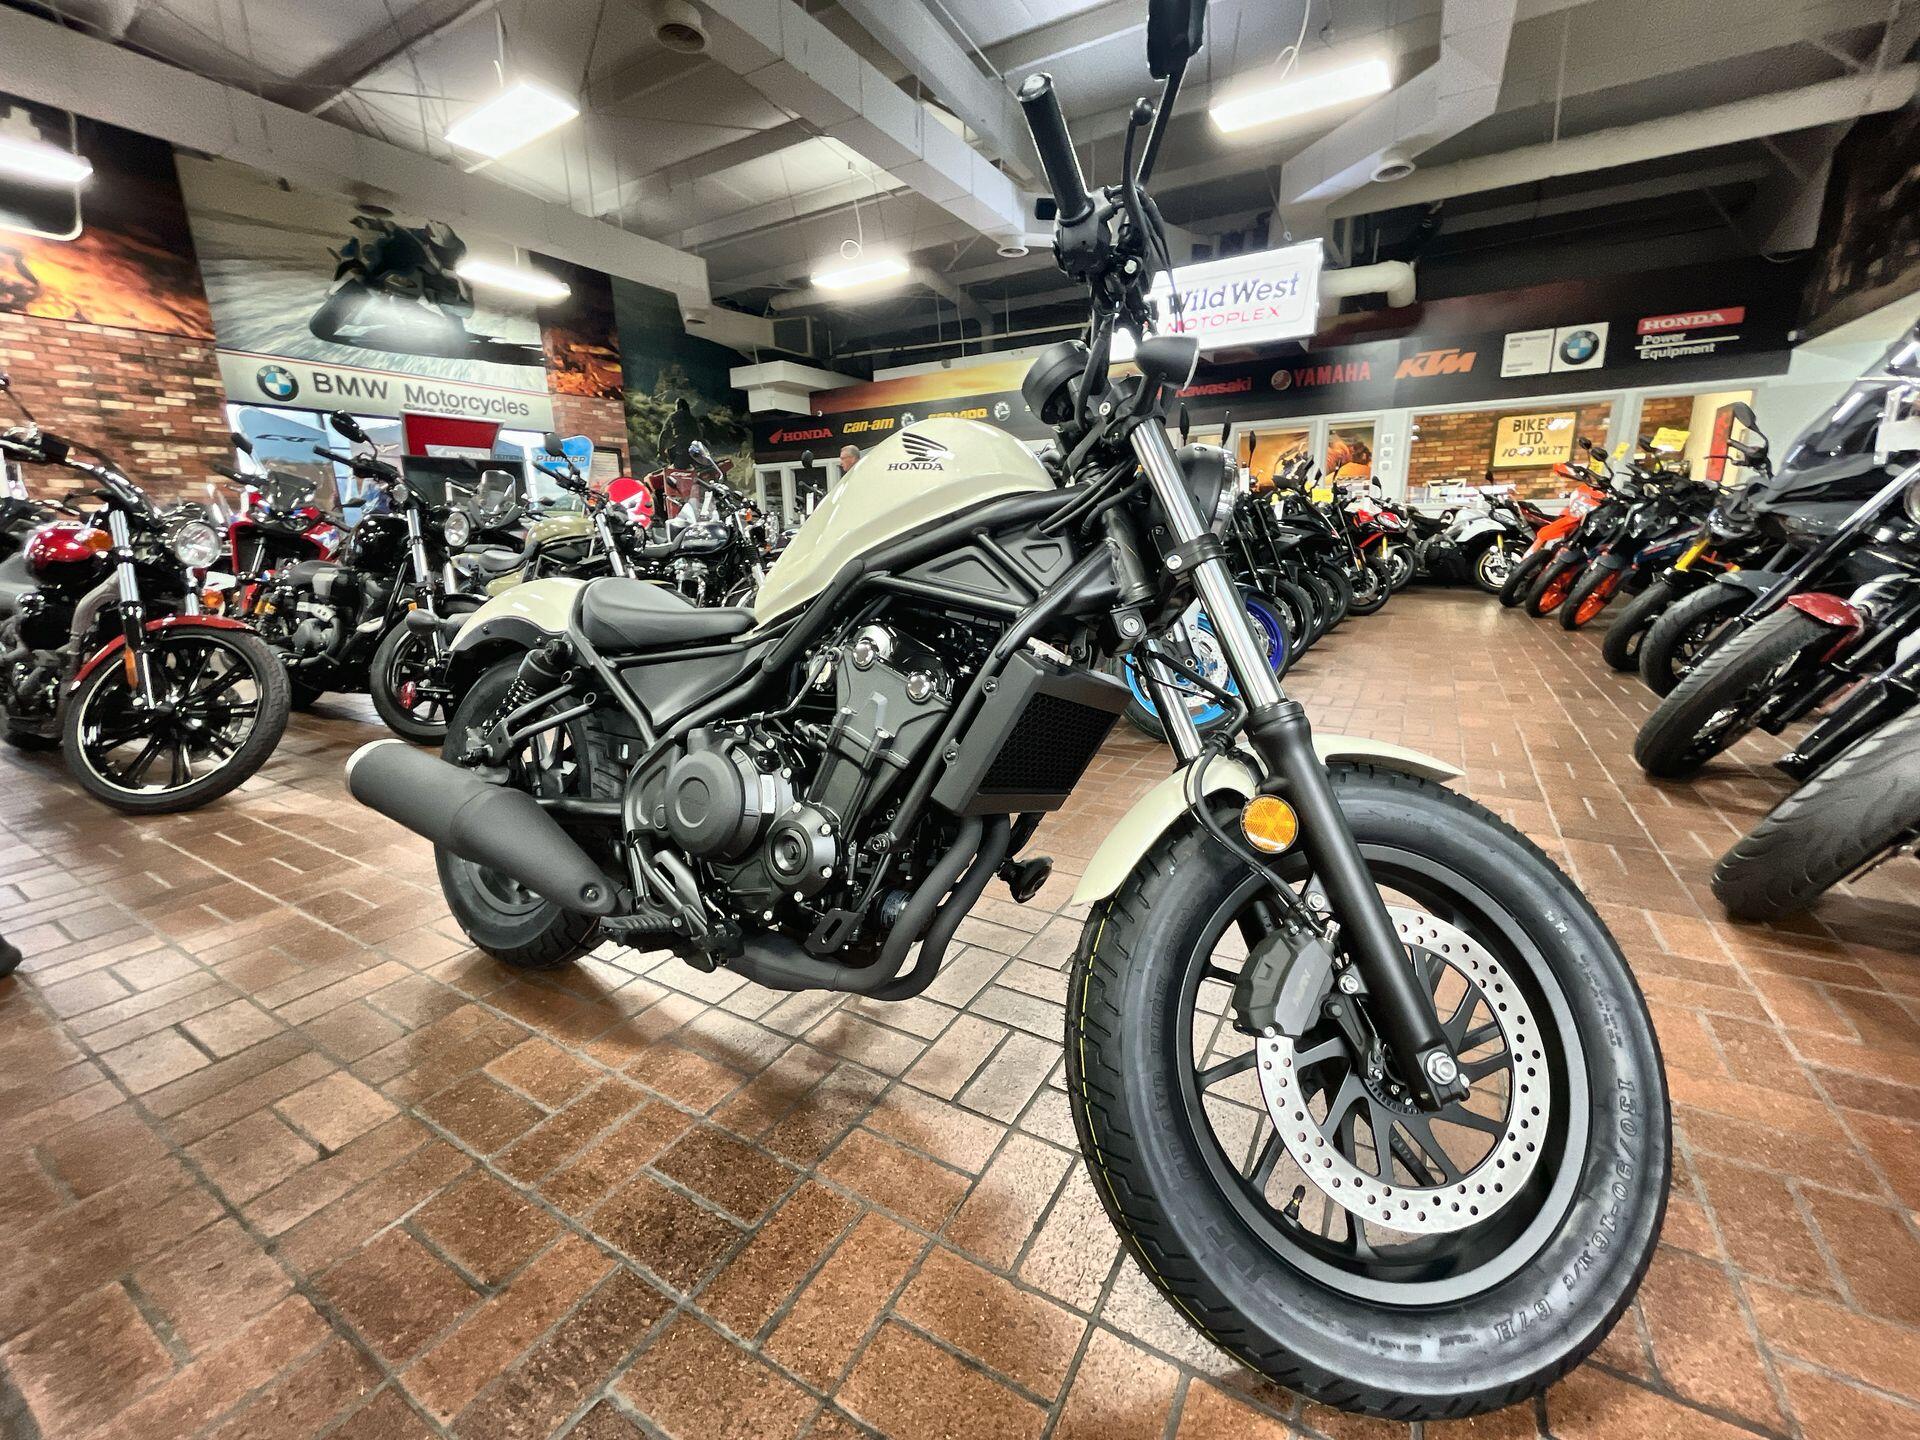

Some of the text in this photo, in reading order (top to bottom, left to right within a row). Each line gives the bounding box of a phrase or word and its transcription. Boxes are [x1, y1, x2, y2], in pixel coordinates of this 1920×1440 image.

[1231, 272, 1300, 305] West
[1165, 305, 1280, 333] MOTOPLEX
[1643, 313, 1725, 330] HONDA
[1642, 333, 1686, 345] Power
[1640, 343, 1715, 360] Equipment
[1394, 348, 1477, 379] KTM
[1294, 360, 1372, 387] YAMAHA
[312, 372, 530, 416] BMW Motorcycles
[842, 418, 895, 433] can-am
[783, 428, 832, 442] HONDA
[1519, 432, 1546, 446] LTD.
[887, 462, 944, 471] HONDA
[1494, 1299, 1551, 1343] 67H
